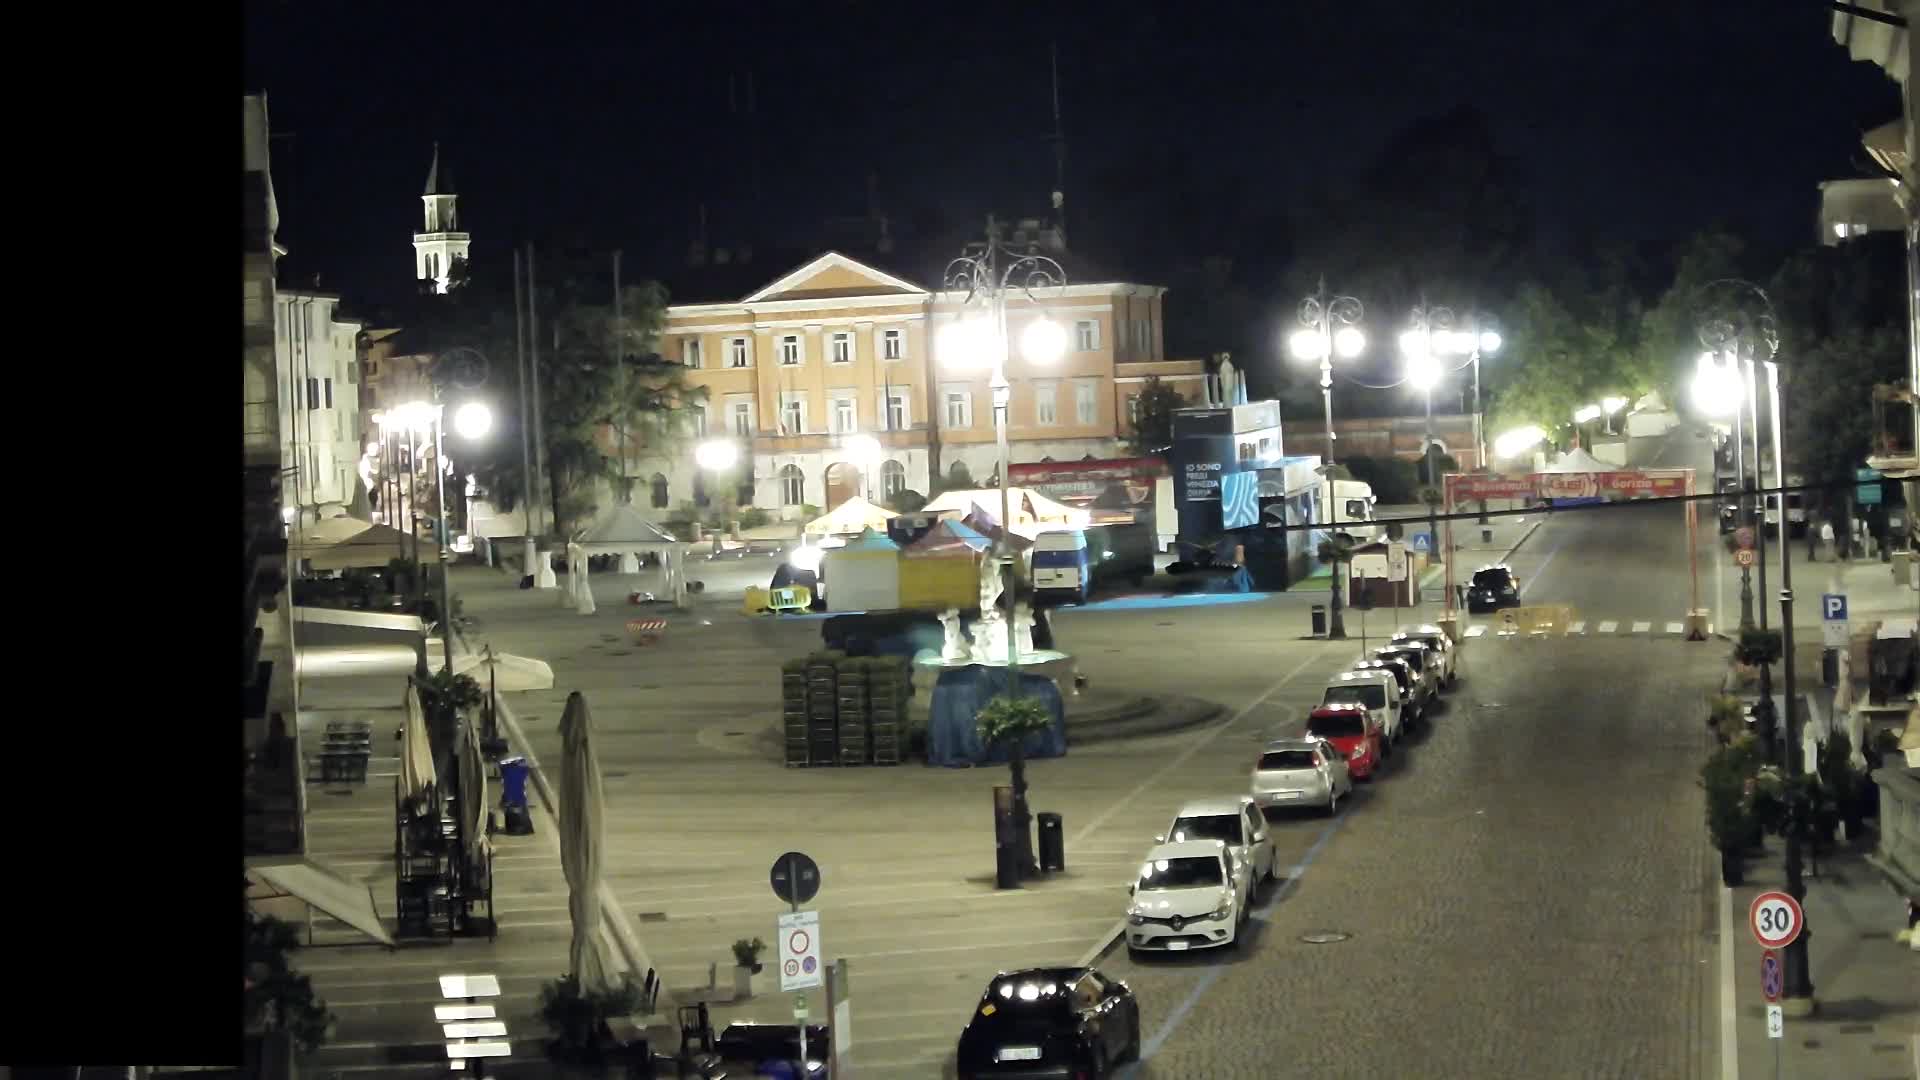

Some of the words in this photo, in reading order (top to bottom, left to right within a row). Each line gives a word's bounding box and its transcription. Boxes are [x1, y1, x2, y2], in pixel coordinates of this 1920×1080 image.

[1196, 463, 1221, 471] SONO
[1828, 597, 1842, 618] P
[1760, 907, 1790, 933] 30
